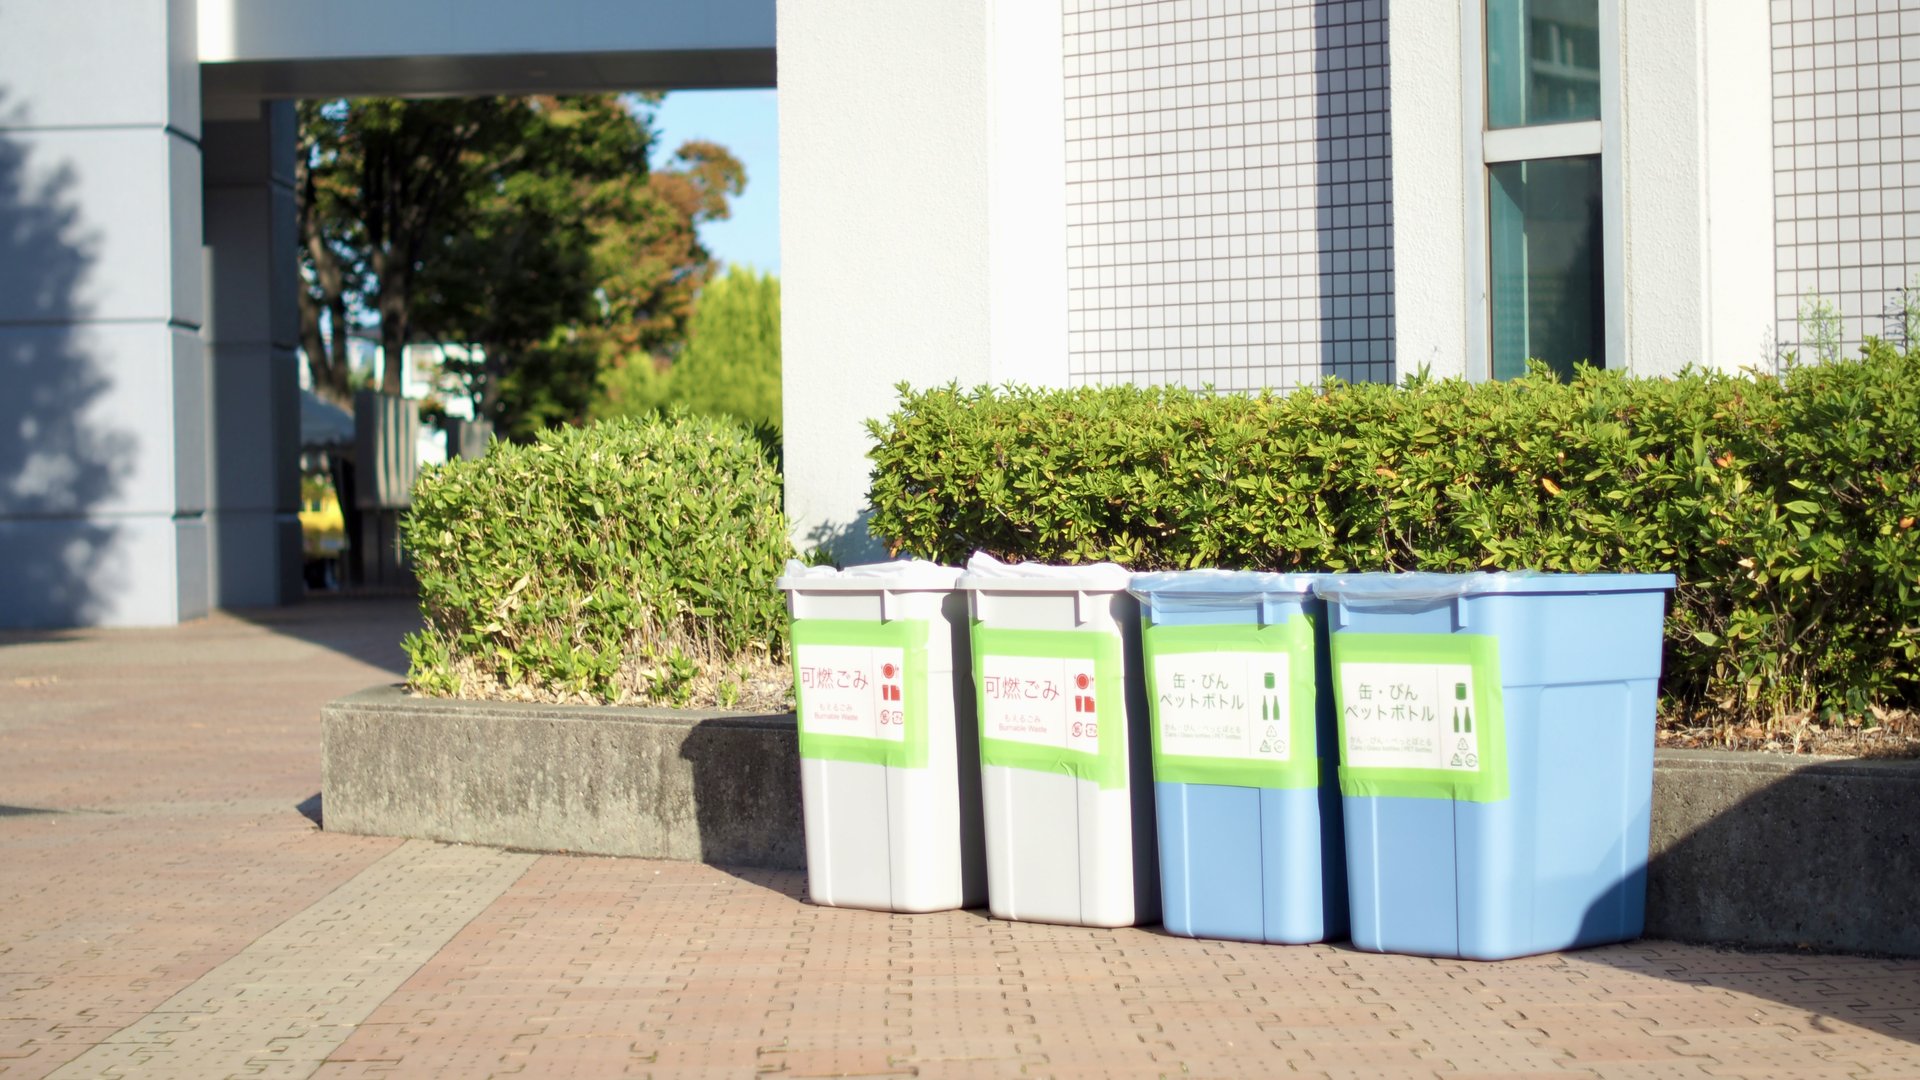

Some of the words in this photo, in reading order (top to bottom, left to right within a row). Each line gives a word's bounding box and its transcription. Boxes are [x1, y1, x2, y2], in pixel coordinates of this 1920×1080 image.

[800, 666, 869, 690] 可燃ごみ
[1173, 672, 1229, 690] 缶・びん
[983, 676, 1060, 701] 可燃ごみ
[1359, 682, 1419, 701] 缶・びん
[1160, 693, 1245, 710] ペットボトル
[1345, 704, 1435, 721] ペットボトル
